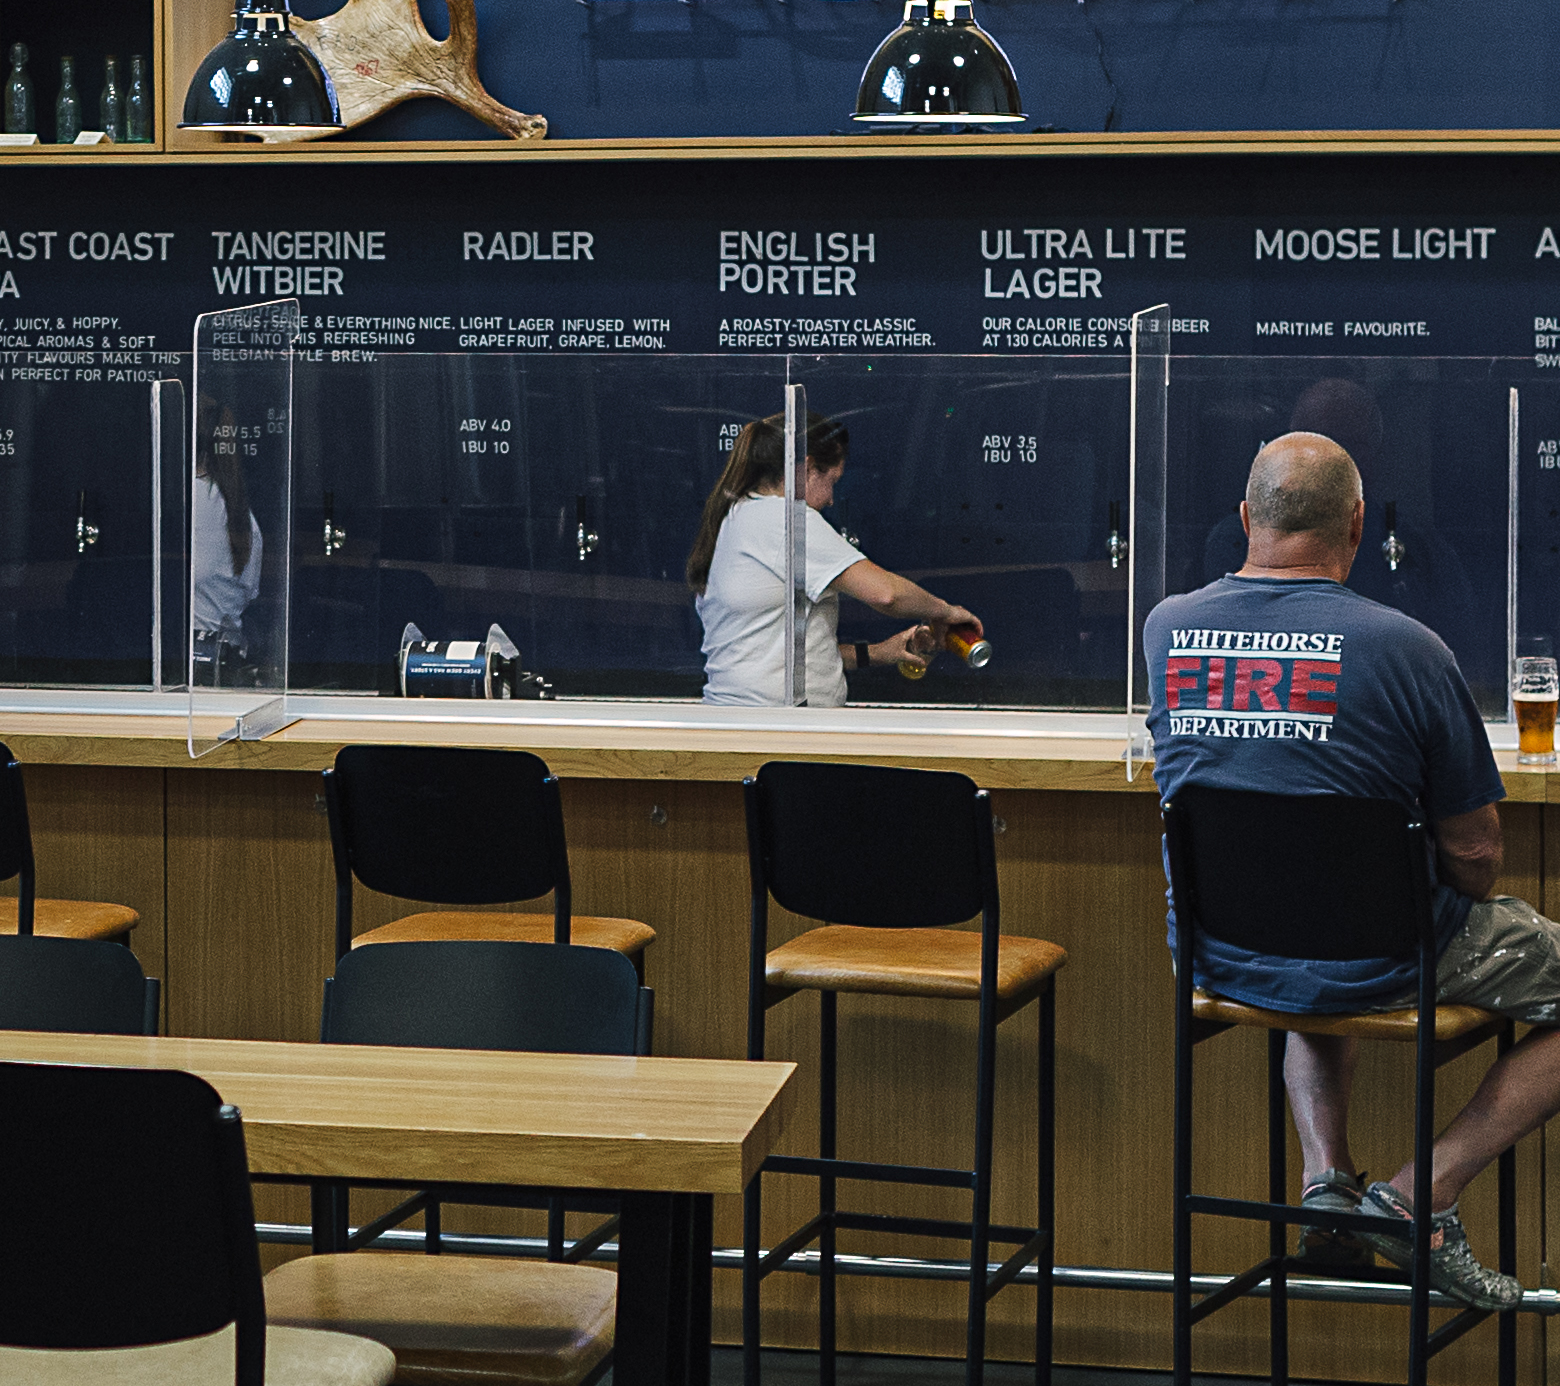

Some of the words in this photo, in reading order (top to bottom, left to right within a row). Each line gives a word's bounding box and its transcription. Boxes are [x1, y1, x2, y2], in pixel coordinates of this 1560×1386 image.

[69, 232, 174, 260] COAST
[211, 231, 385, 259] TANGERINE
[463, 231, 594, 260] RADLER
[720, 231, 875, 262] ENGLISH
[981, 229, 1093, 259] ULTRA
[1106, 228, 1186, 258] LITE
[1255, 228, 1380, 259] MOOSE
[1392, 228, 1496, 259] LIGHT
[213, 266, 343, 295] WITBIER
[719, 263, 856, 295] PORTER
[984, 267, 1102, 298] LAGER
[13, 318, 52, 331] JUICY,
[56, 318, 65, 329] &
[73, 318, 121, 329] HOPPY.
[314, 316, 323, 328] &
[327, 316, 415, 329] EVERYTHING
[419, 317, 455, 330] NICE.
[460, 317, 502, 329] LIGHT
[508, 318, 554, 331] LAGER
[562, 319, 624, 331] INFUSED
[633, 319, 670, 331] WITH
[719, 319, 729, 331] A
[733, 319, 850, 331] ROASTY-TOASTY
[853, 318, 916, 331] CLASSIC
[983, 318, 1011, 330] OUR
[1016, 318, 1082, 331] CALORIE
[1256, 321, 1333, 335] MARITIME
[1345, 321, 1430, 336] FAVOURITE.
[37, 336, 93, 348] AROMAS
[102, 336, 110, 348] &
[119, 336, 155, 348] SOFT
[213, 332, 244, 344] PEEL
[251, 333, 281, 344] INTO
[286, 332, 316, 344] THIS
[324, 332, 415, 345] REFRESHING
[459, 335, 552, 349] GRAPEFRUIT,
[558, 335, 609, 348] GRAPE,
[615, 336, 666, 348] LEMON.
[719, 334, 782, 346] PERFECT
[788, 334, 857, 346] SWEATER
[861, 333, 936, 346] WEATHER.
[982, 334, 1000, 346] AT
[1006, 334, 1029, 346] 130
[1033, 335, 1107, 347] CALORIES
[1113, 335, 1123, 347] A
[28, 352, 94, 363] FLAVOURS
[103, 352, 141, 363] MAKE
[151, 352, 181, 363] THIS
[213, 350, 274, 361] BELGIAN
[332, 350, 378, 362] BREW.
[12, 369, 69, 380] PERFECT
[76, 369, 101, 380] FOR
[460, 419, 486, 431] ABV
[491, 419, 511, 431] 4.0
[213, 426, 237, 438] ABV
[241, 427, 261, 438] 5.5
[214, 443, 236, 454] IBU
[244, 444, 257, 455] 15
[462, 441, 486, 453] IBU
[493, 441, 509, 453] 10
[982, 436, 1011, 448] ABV
[1017, 436, 1036, 449] 3.5
[984, 451, 1011, 462] IBU
[1019, 451, 1036, 462] 10
[1171, 629, 1344, 653] WHITEHORSE
[1166, 657, 1342, 714] FIRE
[1169, 717, 1332, 741] DEPARTMENT
